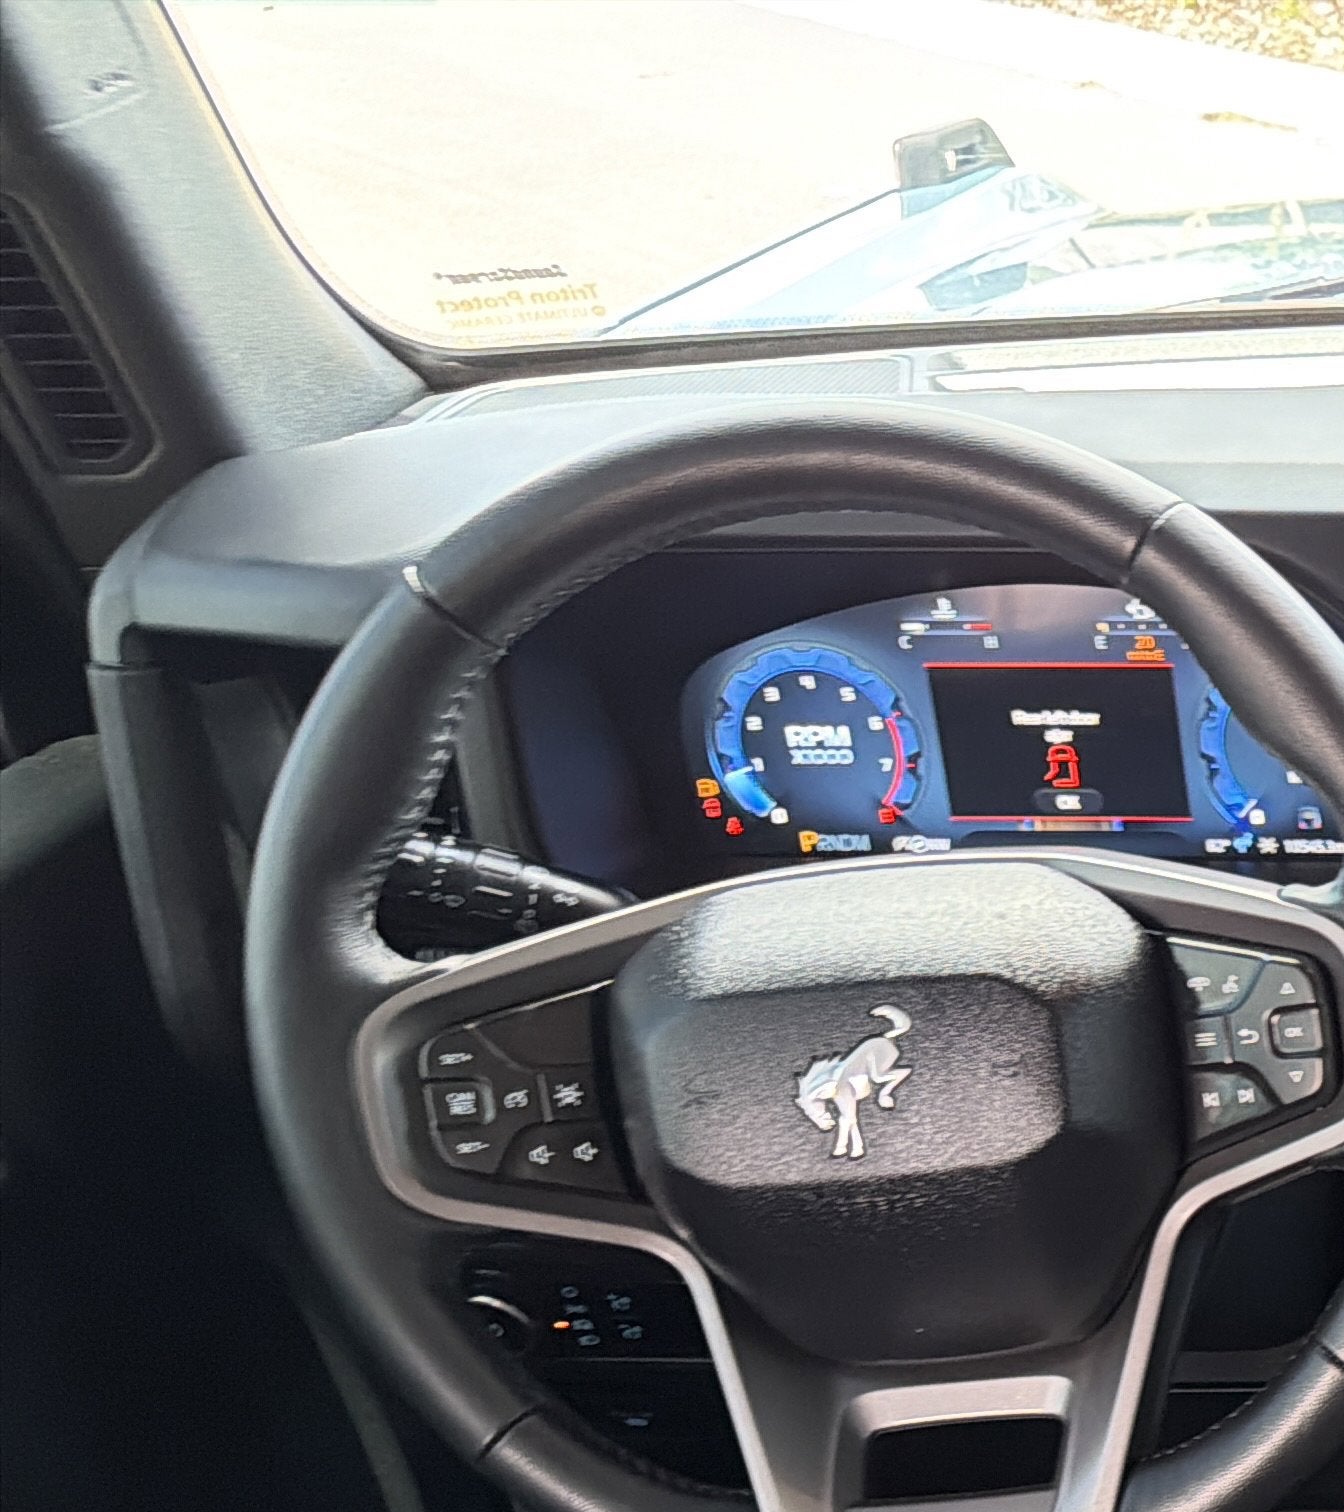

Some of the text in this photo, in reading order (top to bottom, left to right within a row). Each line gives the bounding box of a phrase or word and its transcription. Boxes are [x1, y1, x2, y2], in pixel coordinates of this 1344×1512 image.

[763, 687, 780, 702] 3
[839, 687, 856, 702] 5
[745, 716, 763, 731] 2
[867, 716, 885, 731] 6
[784, 725, 852, 747] RPM
